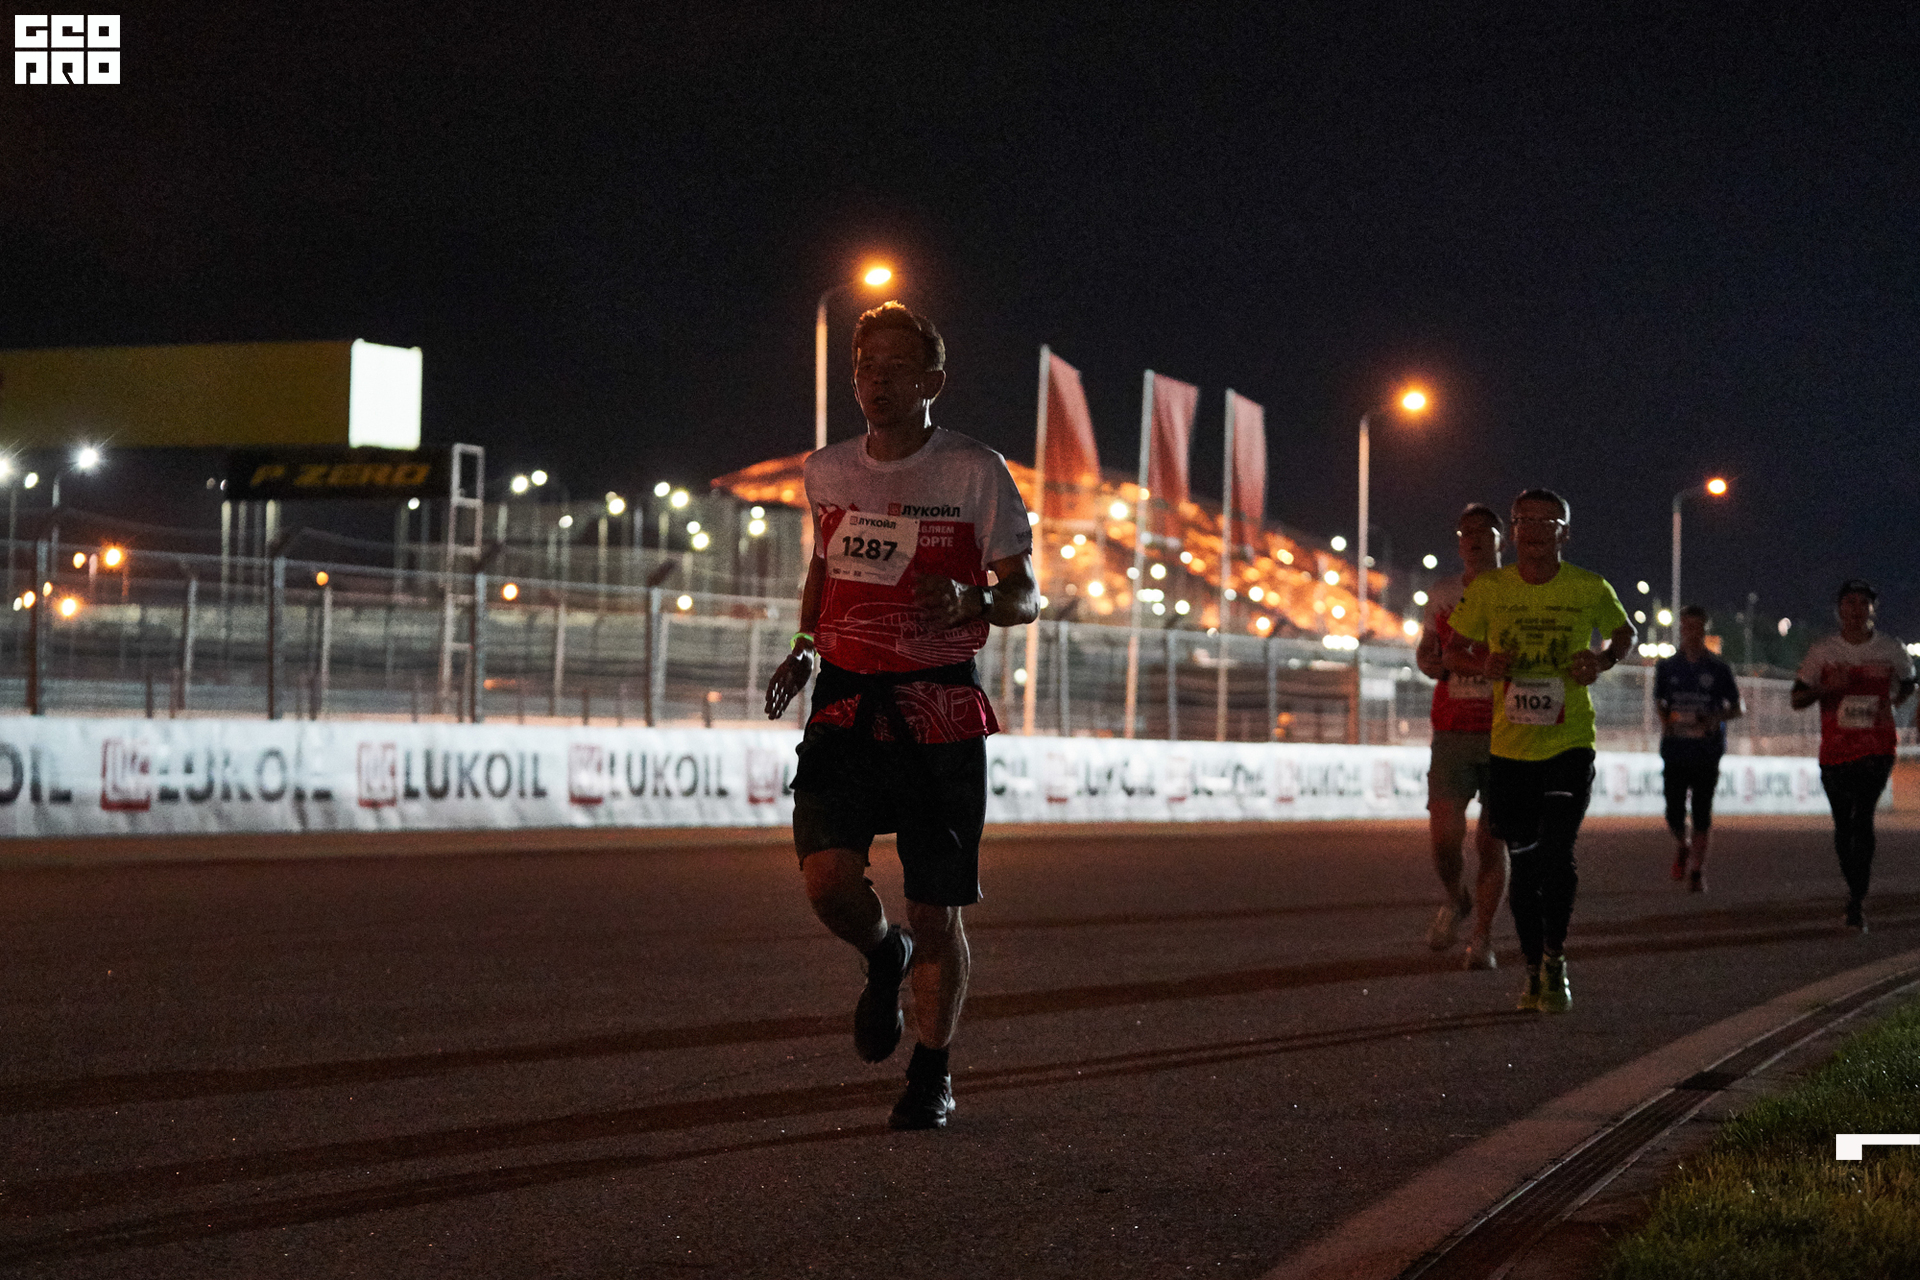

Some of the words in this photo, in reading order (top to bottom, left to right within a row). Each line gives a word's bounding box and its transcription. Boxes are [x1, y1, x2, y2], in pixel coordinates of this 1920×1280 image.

[293, 463, 432, 487] ZERO
[902, 504, 960, 518] ЛУКОЙЛ
[858, 517, 897, 529] ЛУКОЙЛ
[918, 525, 955, 535] ВЛЯЕМ
[842, 535, 898, 562] 1287
[1514, 695, 1552, 711] 1102
[404, 749, 548, 800] LUKOIL
[609, 751, 729, 799] LUKOIL
